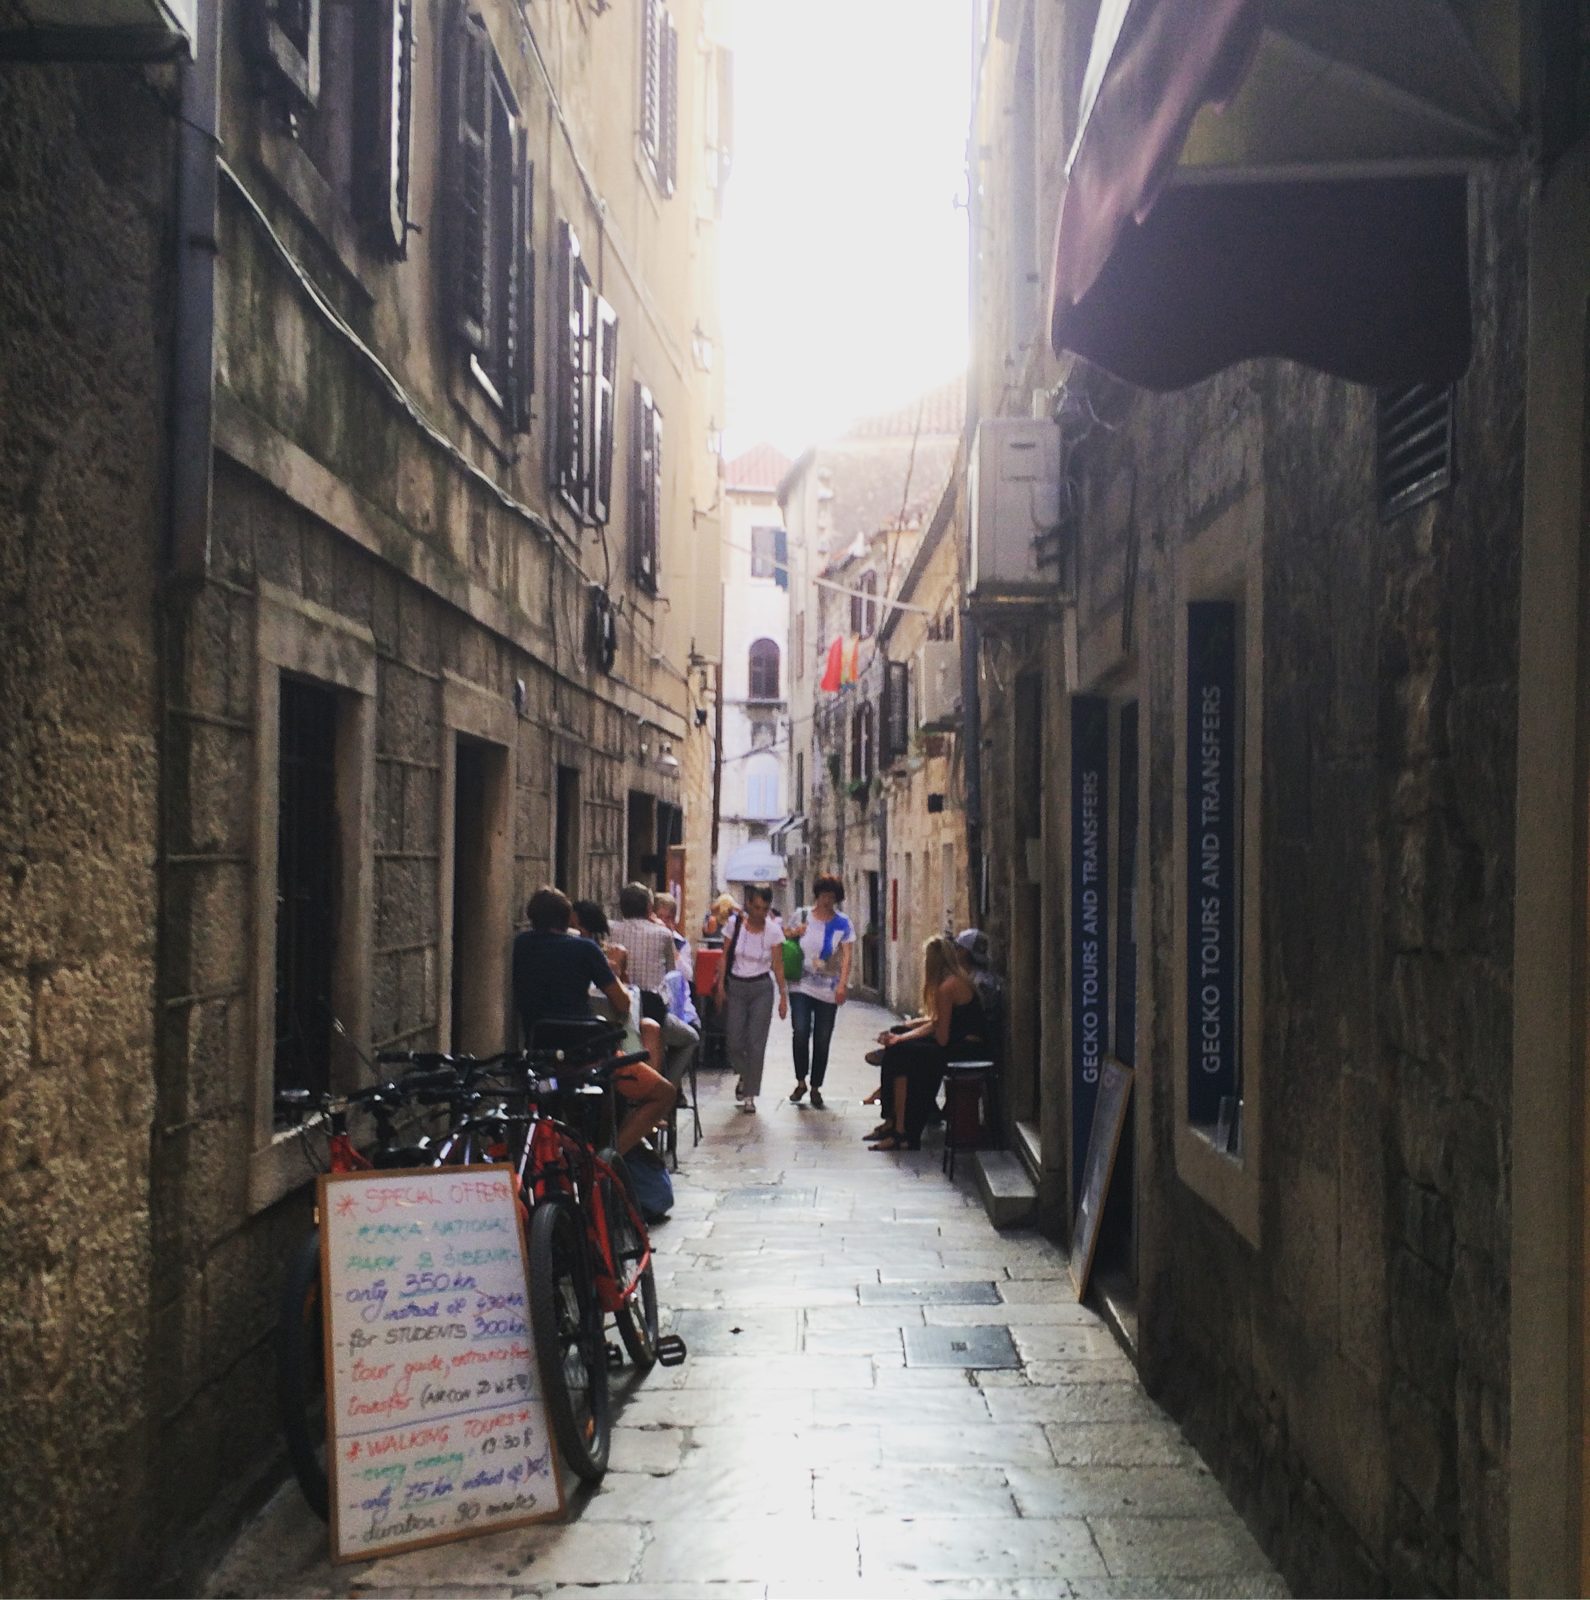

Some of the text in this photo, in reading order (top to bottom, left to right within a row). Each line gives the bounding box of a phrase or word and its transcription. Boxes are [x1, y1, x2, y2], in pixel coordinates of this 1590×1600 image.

[1083, 770, 1098, 1083] GECKO TOURS AND TRANSFERS
[1202, 685, 1220, 1074] GECKO TOURS AND TRANSFERS
[385, 1323, 468, 1345] STUDENTS
[366, 1425, 449, 1456] WALKING
